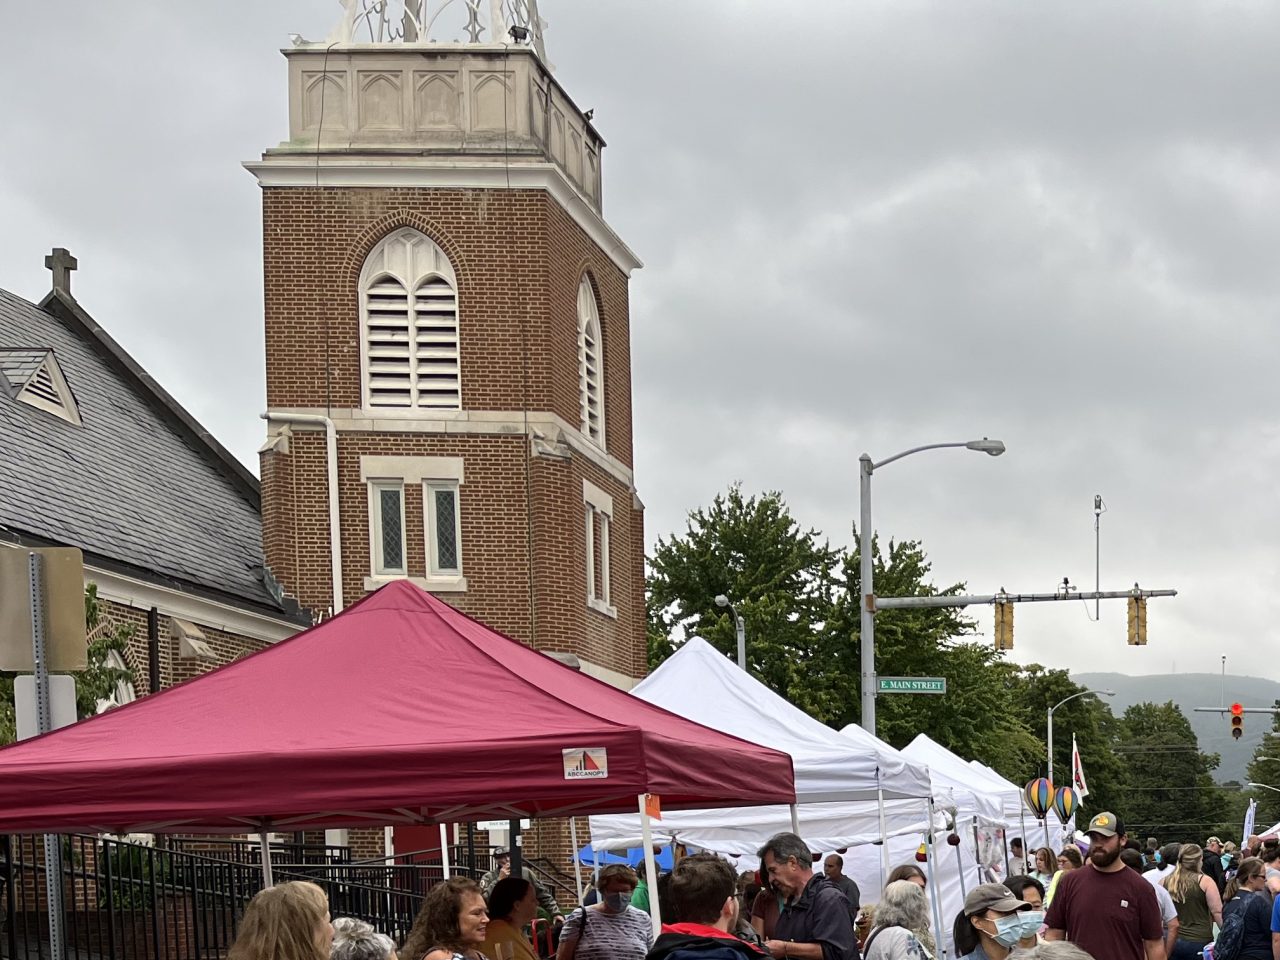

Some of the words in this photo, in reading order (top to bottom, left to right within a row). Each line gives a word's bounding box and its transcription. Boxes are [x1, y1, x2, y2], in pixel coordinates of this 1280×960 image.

[881, 680, 889, 689] E.
[890, 681, 911, 689] MAIN
[912, 681, 942, 689] STREET
